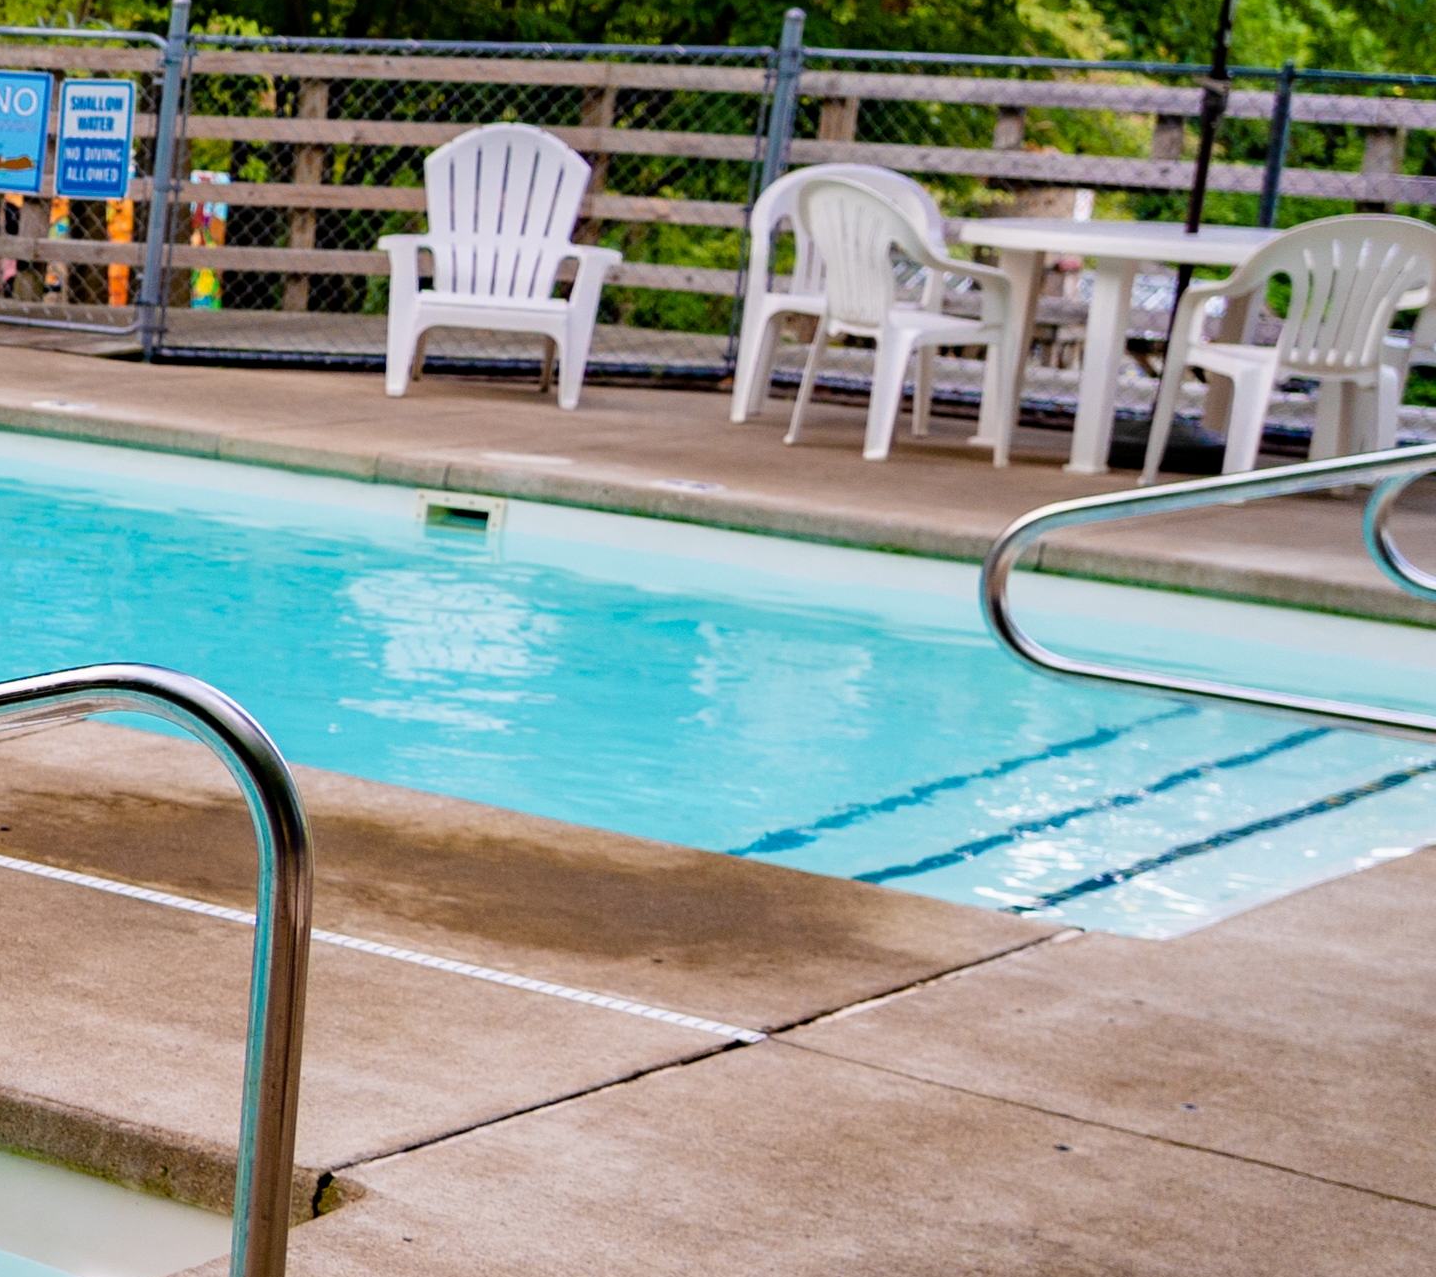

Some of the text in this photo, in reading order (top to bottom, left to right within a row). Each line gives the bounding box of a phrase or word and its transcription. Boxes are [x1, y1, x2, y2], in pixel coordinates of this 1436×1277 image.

[70, 96, 123, 111] SHALLOW
[77, 116, 115, 131] WATER
[65, 146, 122, 162] NO DIVING
[67, 166, 119, 182] ALLOWED
